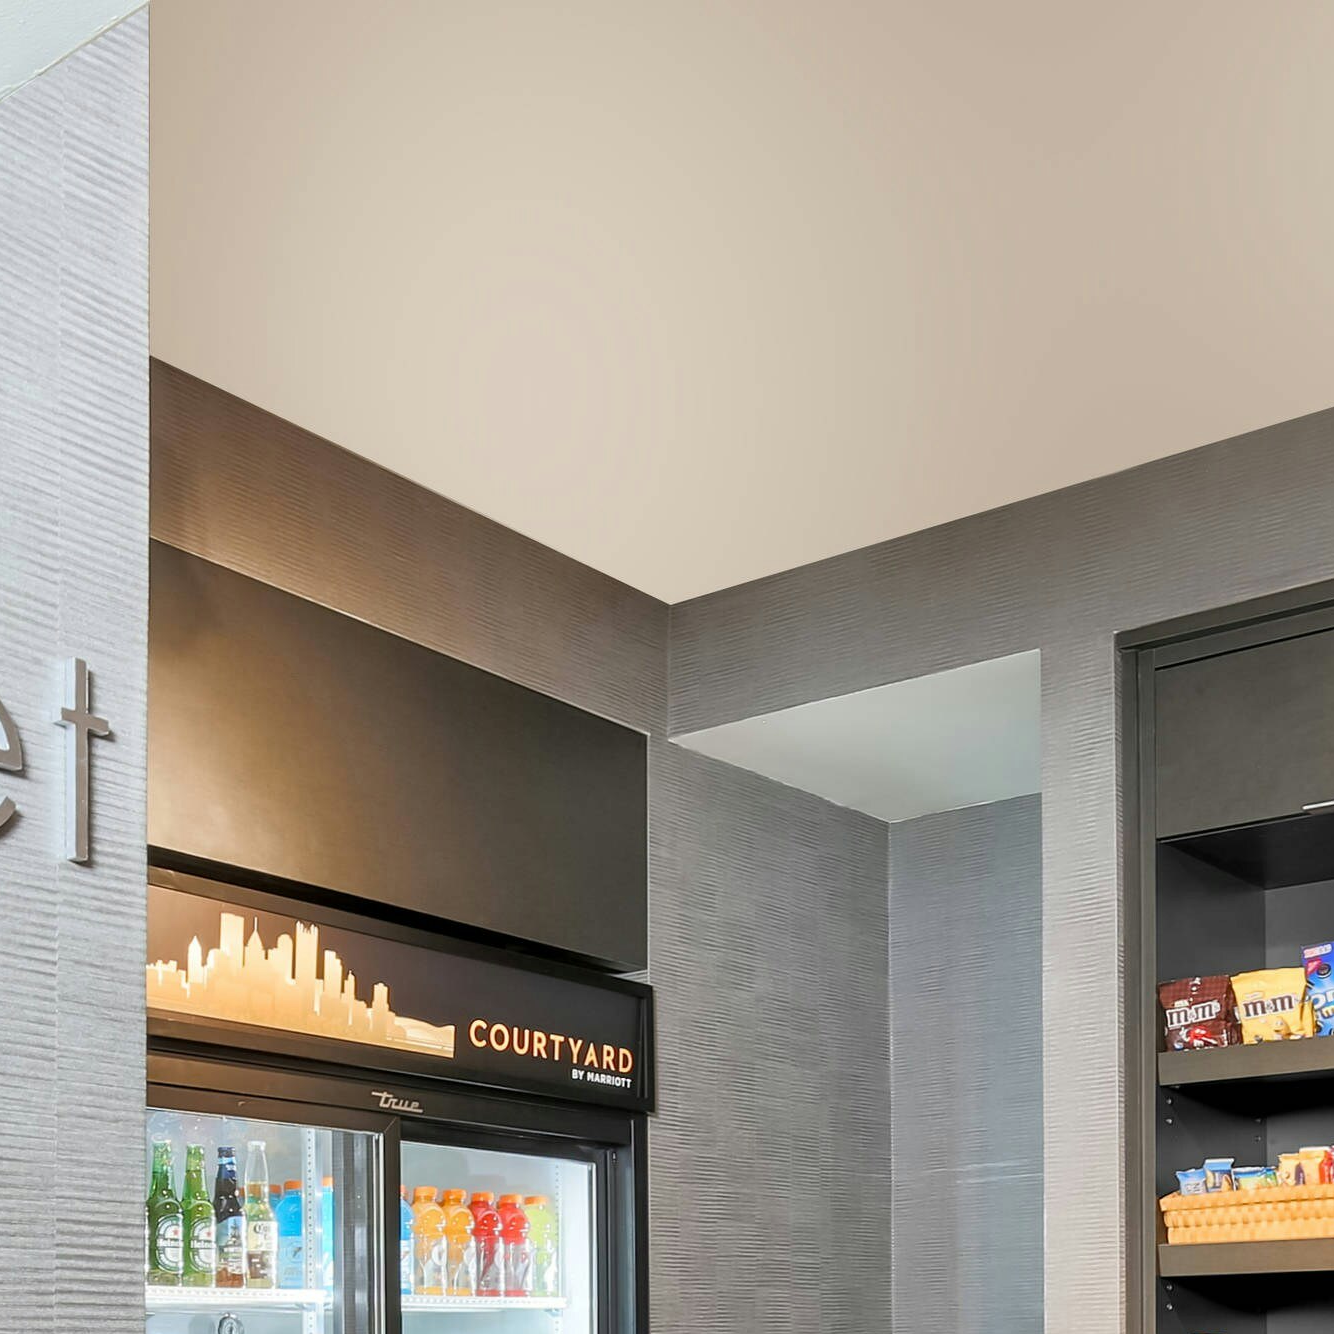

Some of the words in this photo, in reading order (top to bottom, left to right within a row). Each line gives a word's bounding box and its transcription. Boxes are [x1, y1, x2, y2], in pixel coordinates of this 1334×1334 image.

[469, 1019, 633, 1073] COURTYARD
[572, 1069, 585, 1081] BY
[587, 1071, 632, 1088] MARRIOTT
